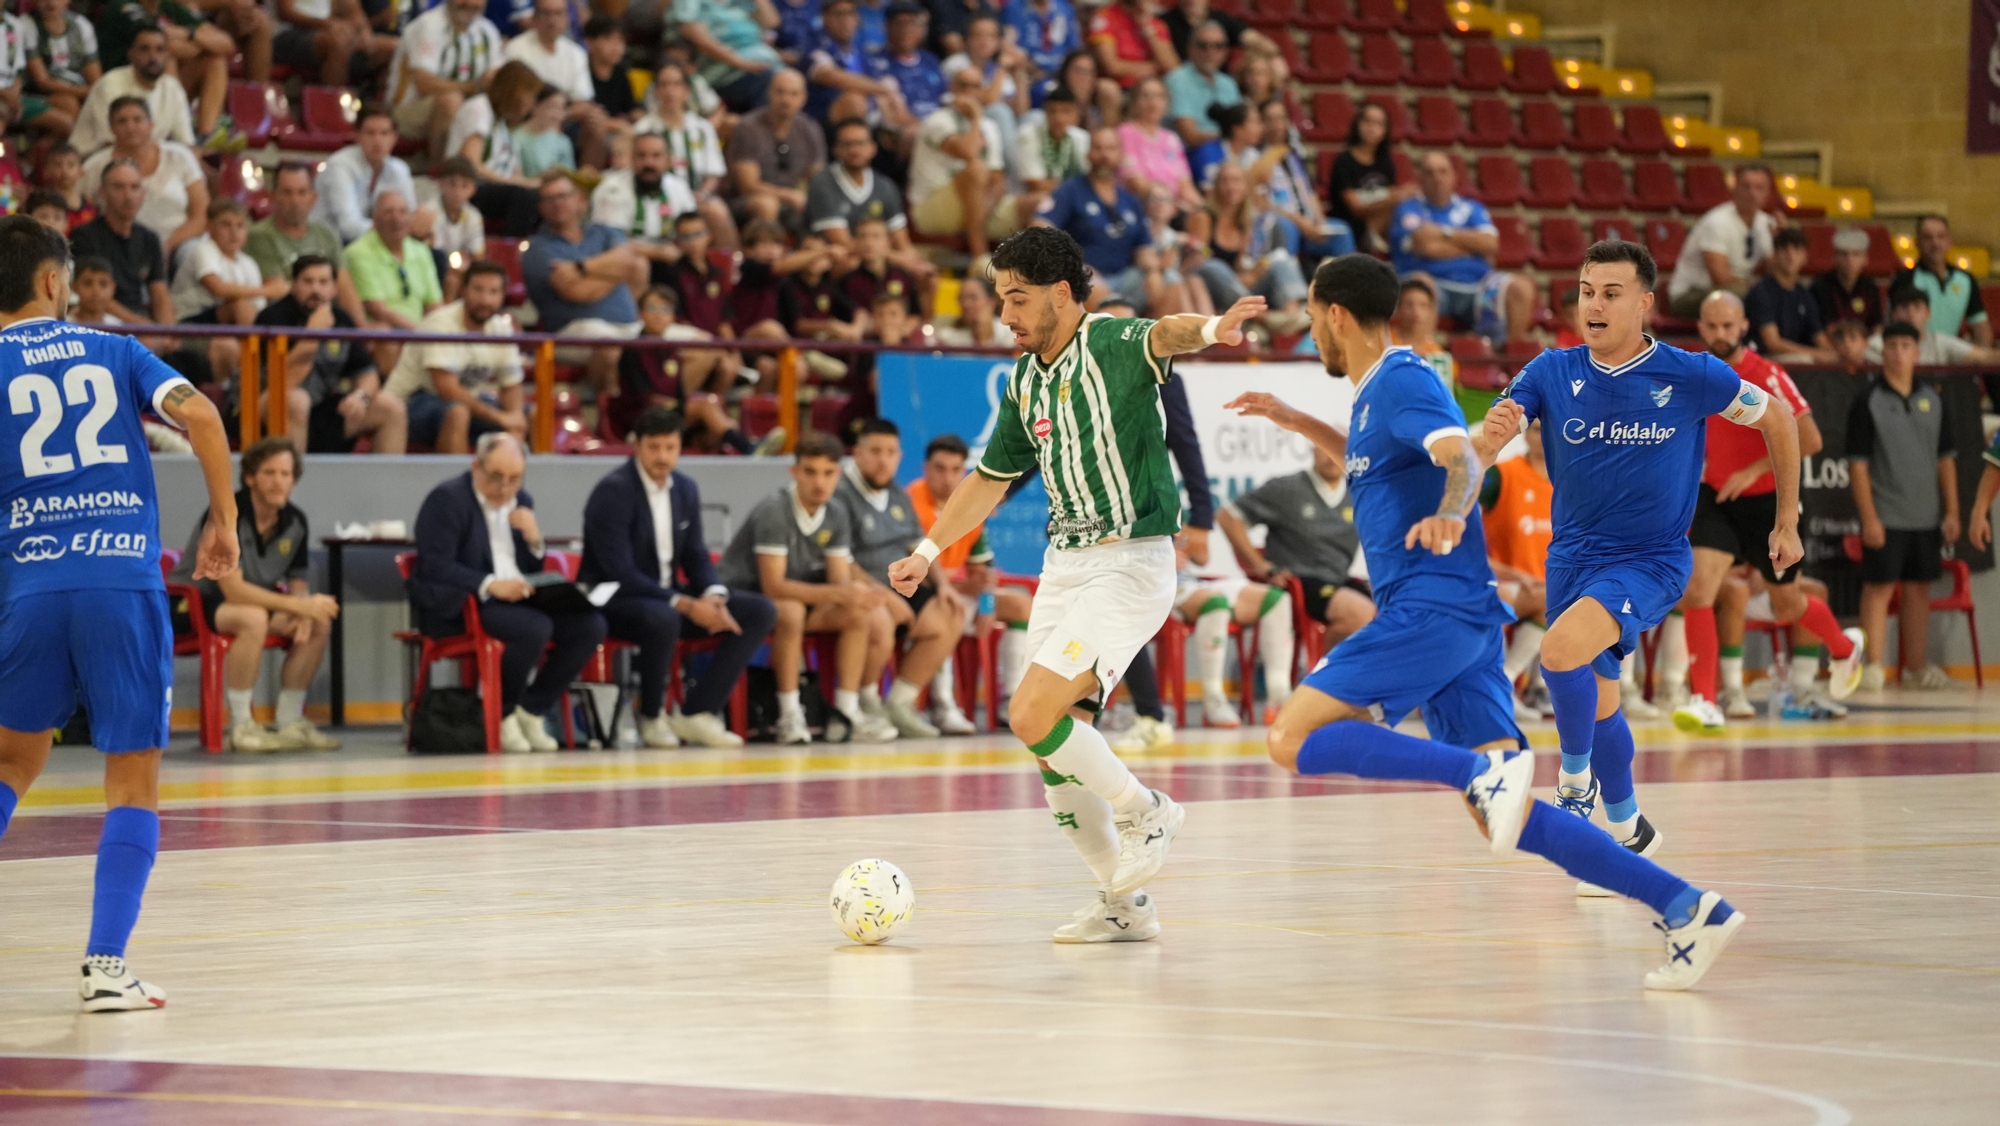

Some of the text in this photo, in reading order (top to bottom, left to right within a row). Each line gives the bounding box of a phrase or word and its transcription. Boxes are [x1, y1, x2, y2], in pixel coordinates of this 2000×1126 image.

[22, 340, 87, 367] KHALID
[8, 363, 129, 478] 22
[1588, 421, 1676, 444] el hidalgo
[1214, 423, 1312, 462] GRUPO
[40, 513, 74, 523] OBRAS
[71, 528, 147, 556] Efran
